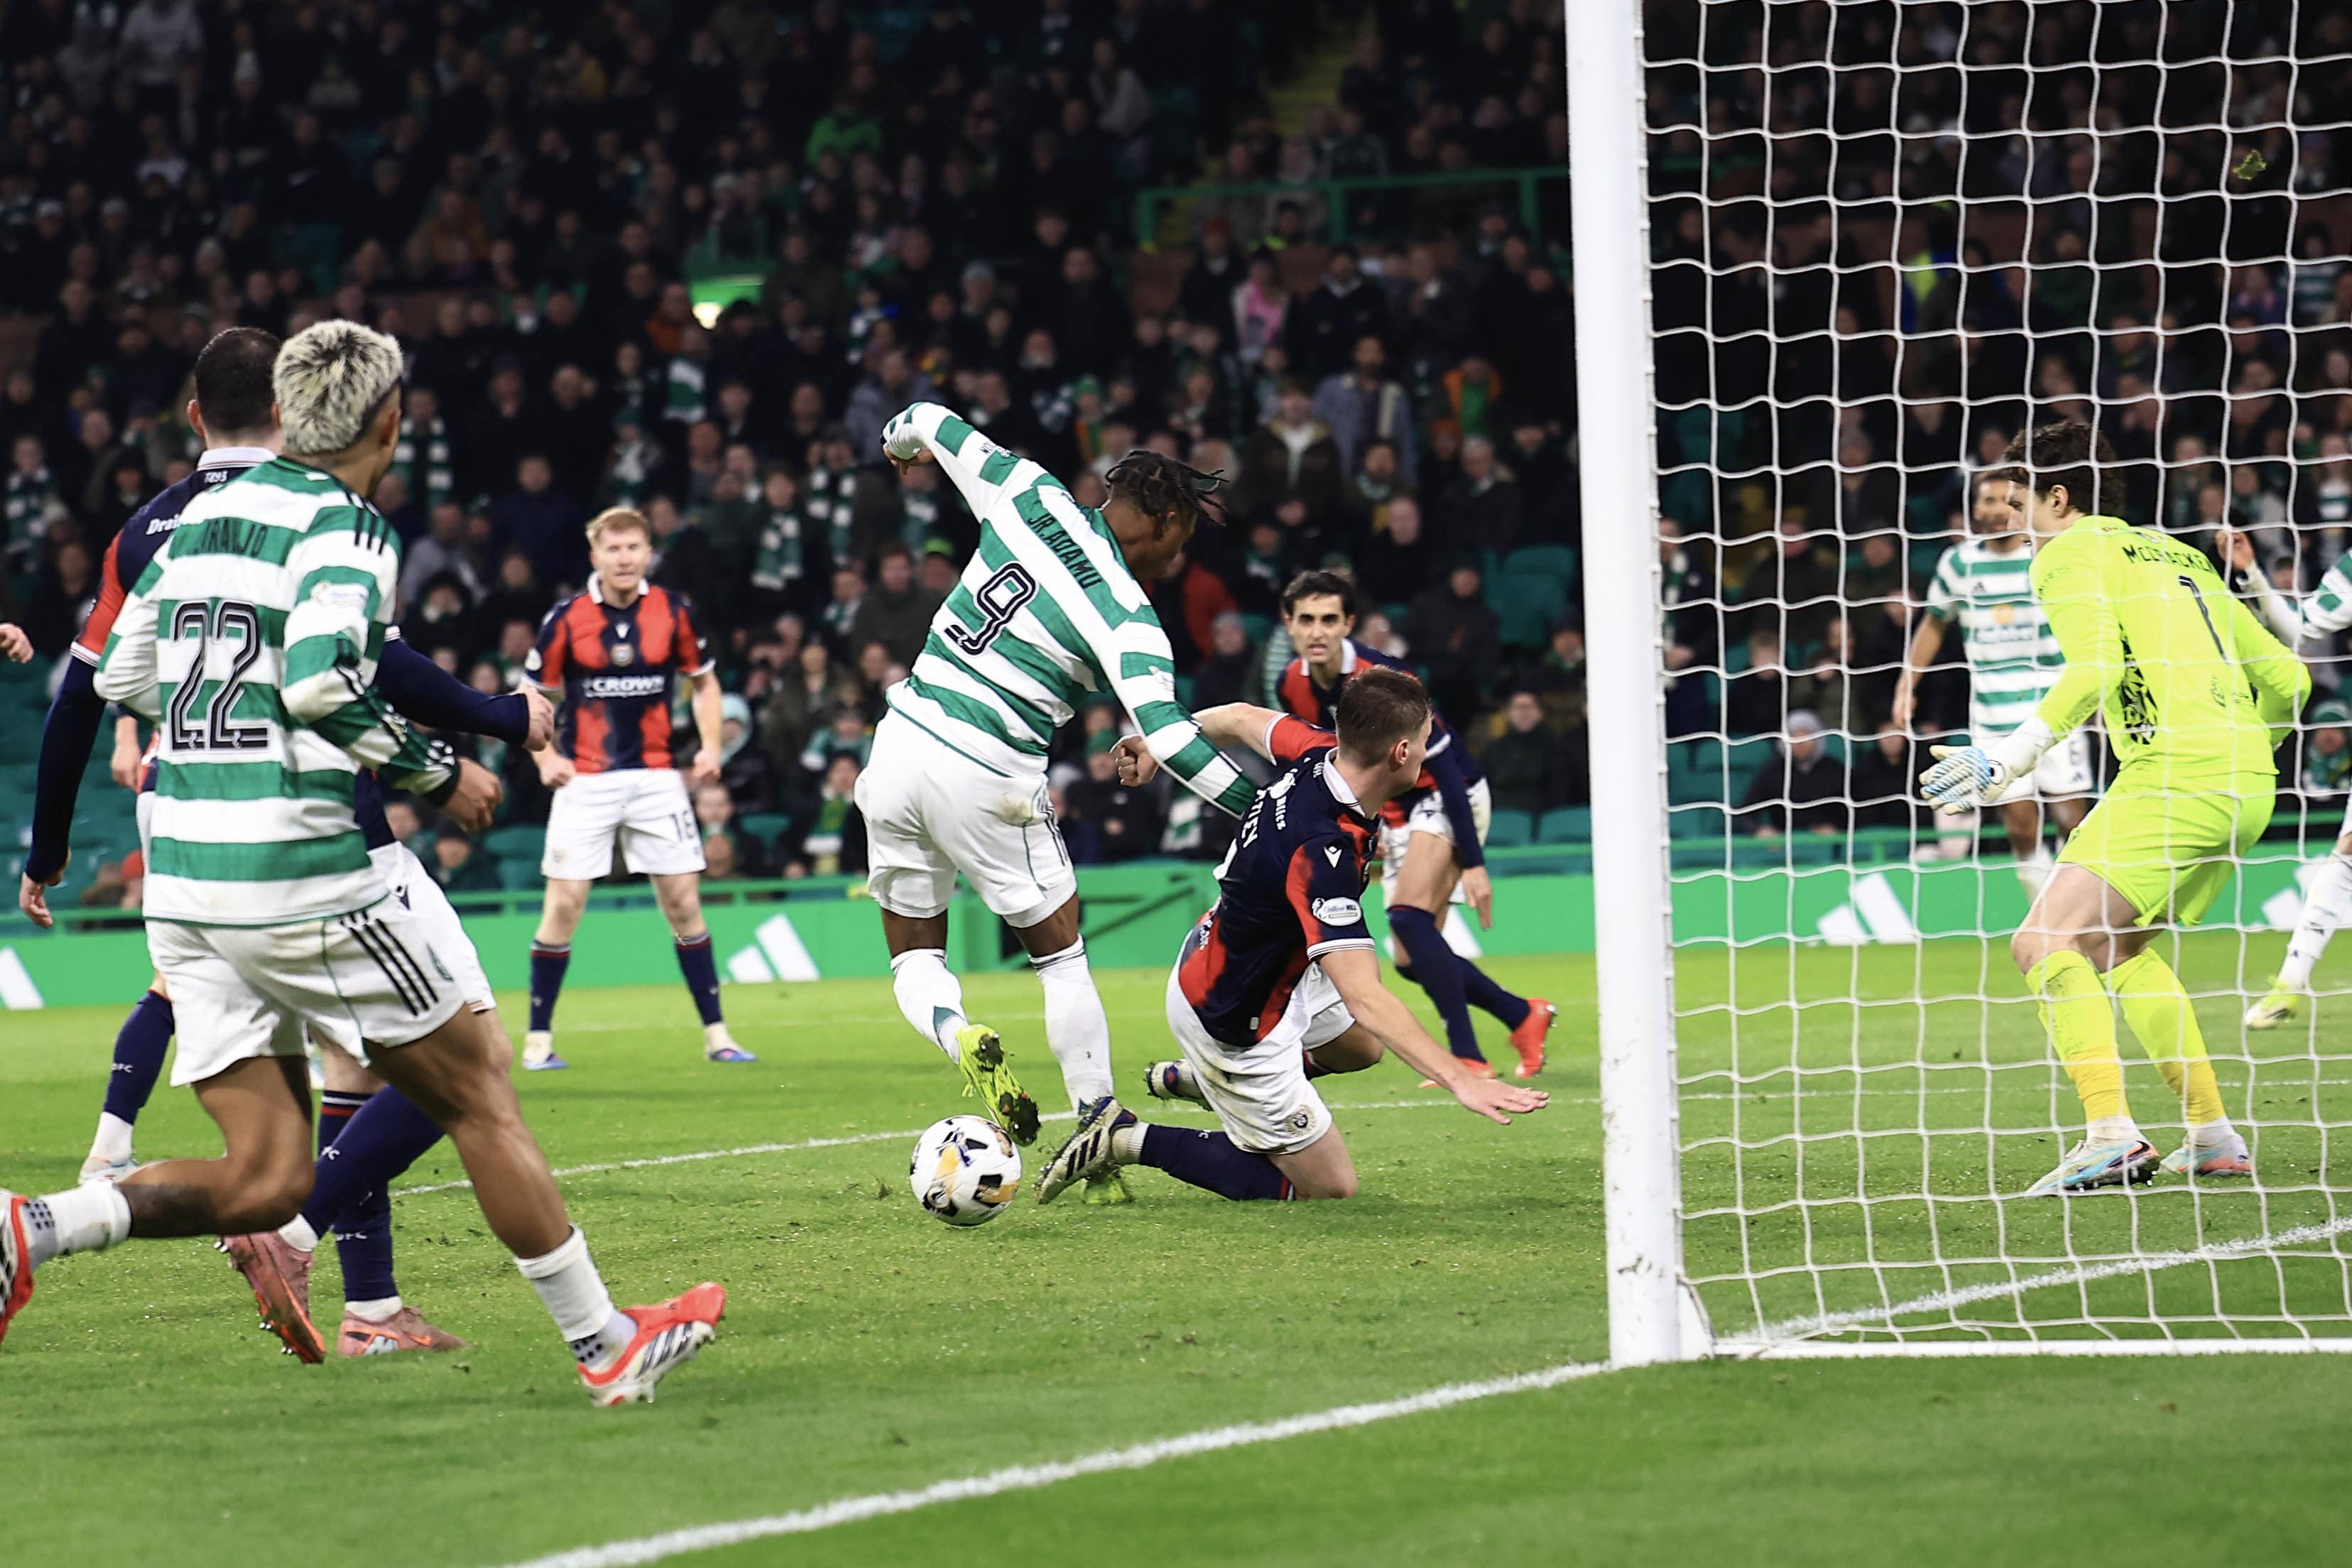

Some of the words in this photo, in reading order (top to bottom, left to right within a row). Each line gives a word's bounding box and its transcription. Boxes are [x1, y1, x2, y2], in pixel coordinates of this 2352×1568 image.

[146, 514, 183, 535] Drai
[943, 561, 1038, 656] 9
[166, 599, 273, 753] 22
